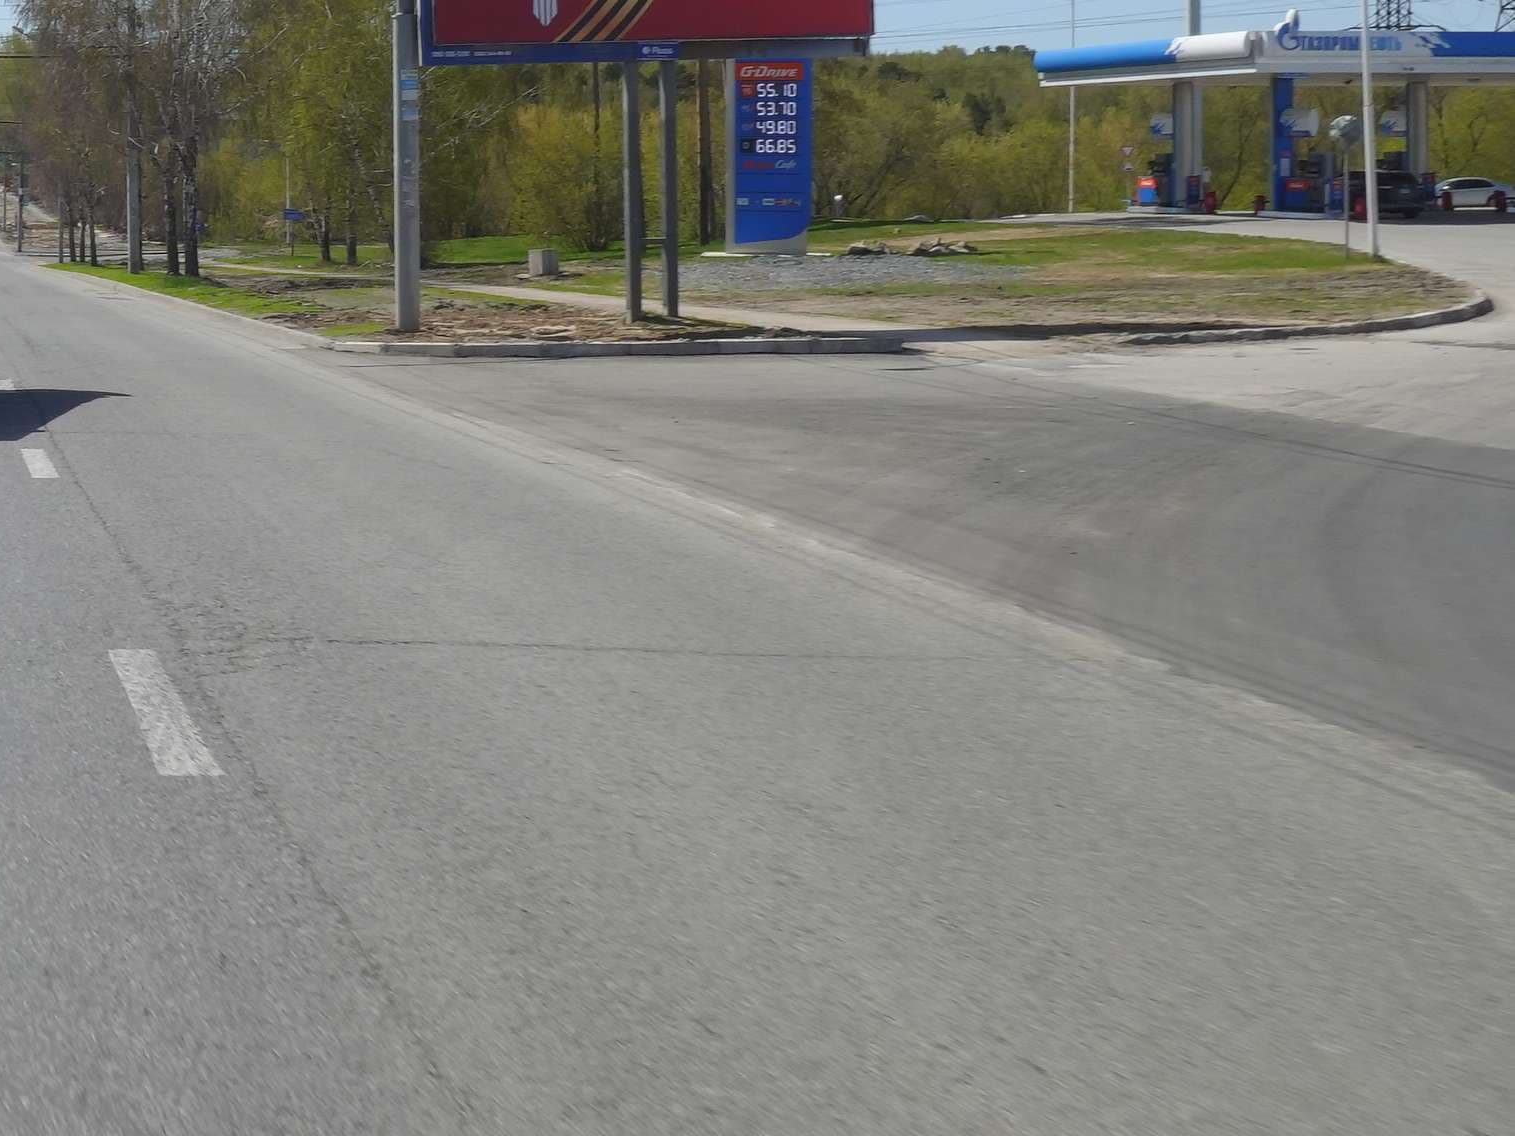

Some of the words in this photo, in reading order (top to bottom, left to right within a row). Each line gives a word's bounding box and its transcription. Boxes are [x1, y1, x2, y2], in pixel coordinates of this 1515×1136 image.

[756, 83, 798, 97] 55.10
[756, 102, 797, 116] 53.70
[755, 120, 797, 134] 49.80
[755, 139, 797, 153] 66.85
